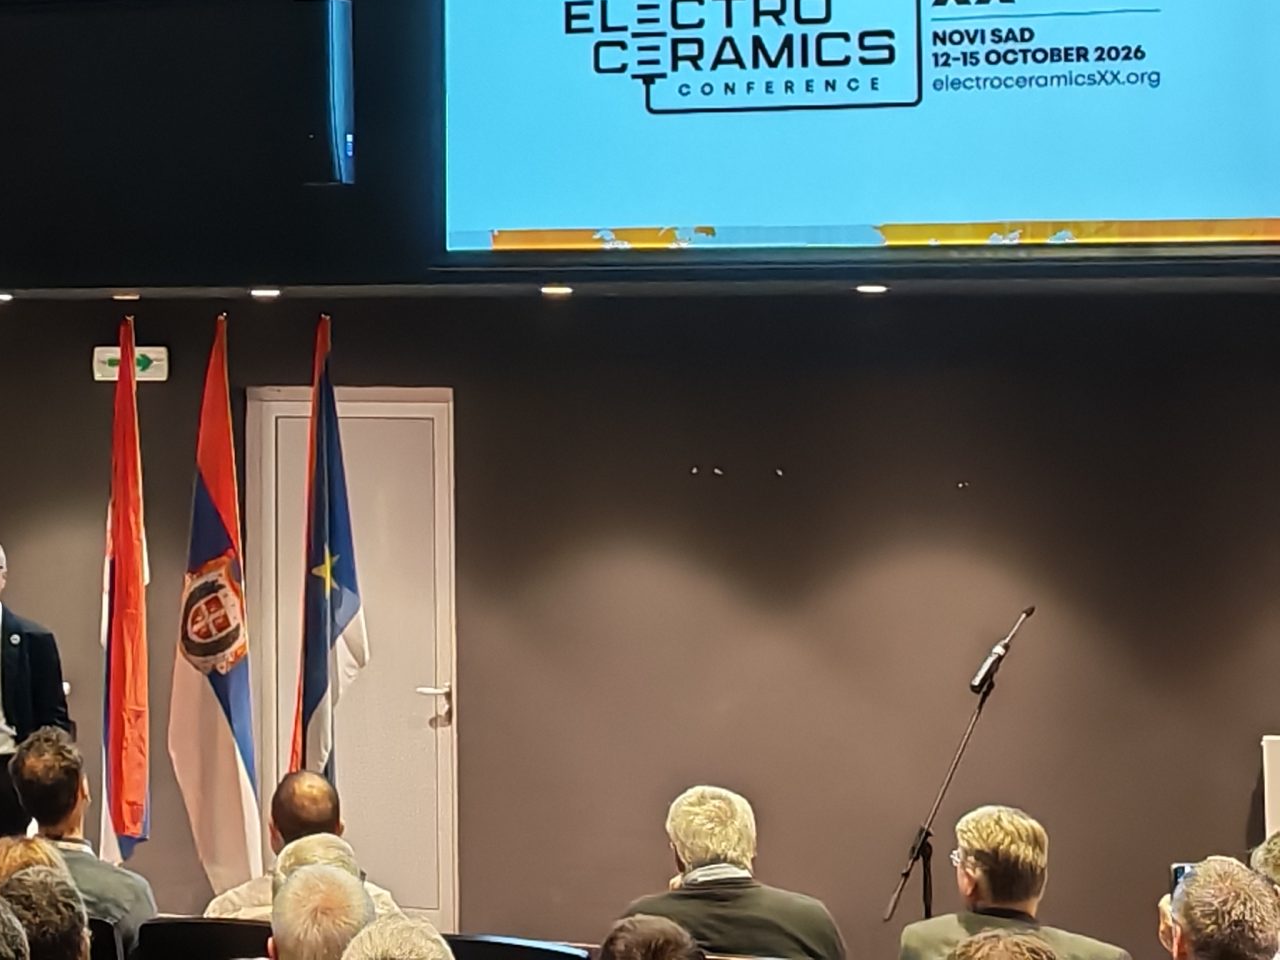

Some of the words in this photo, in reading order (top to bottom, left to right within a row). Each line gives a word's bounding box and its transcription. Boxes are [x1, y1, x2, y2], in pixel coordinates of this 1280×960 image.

[932, 29, 986, 46] NOVI
[990, 27, 1035, 44] SAD
[593, 30, 896, 78] CERAMICS
[932, 52, 980, 68] 12-15
[984, 46, 1089, 65] OCTOBER
[1094, 45, 1146, 62] 2026
[678, 77, 880, 96] CONFERENCE
[932, 70, 1161, 92] electroceramicsXX.org
